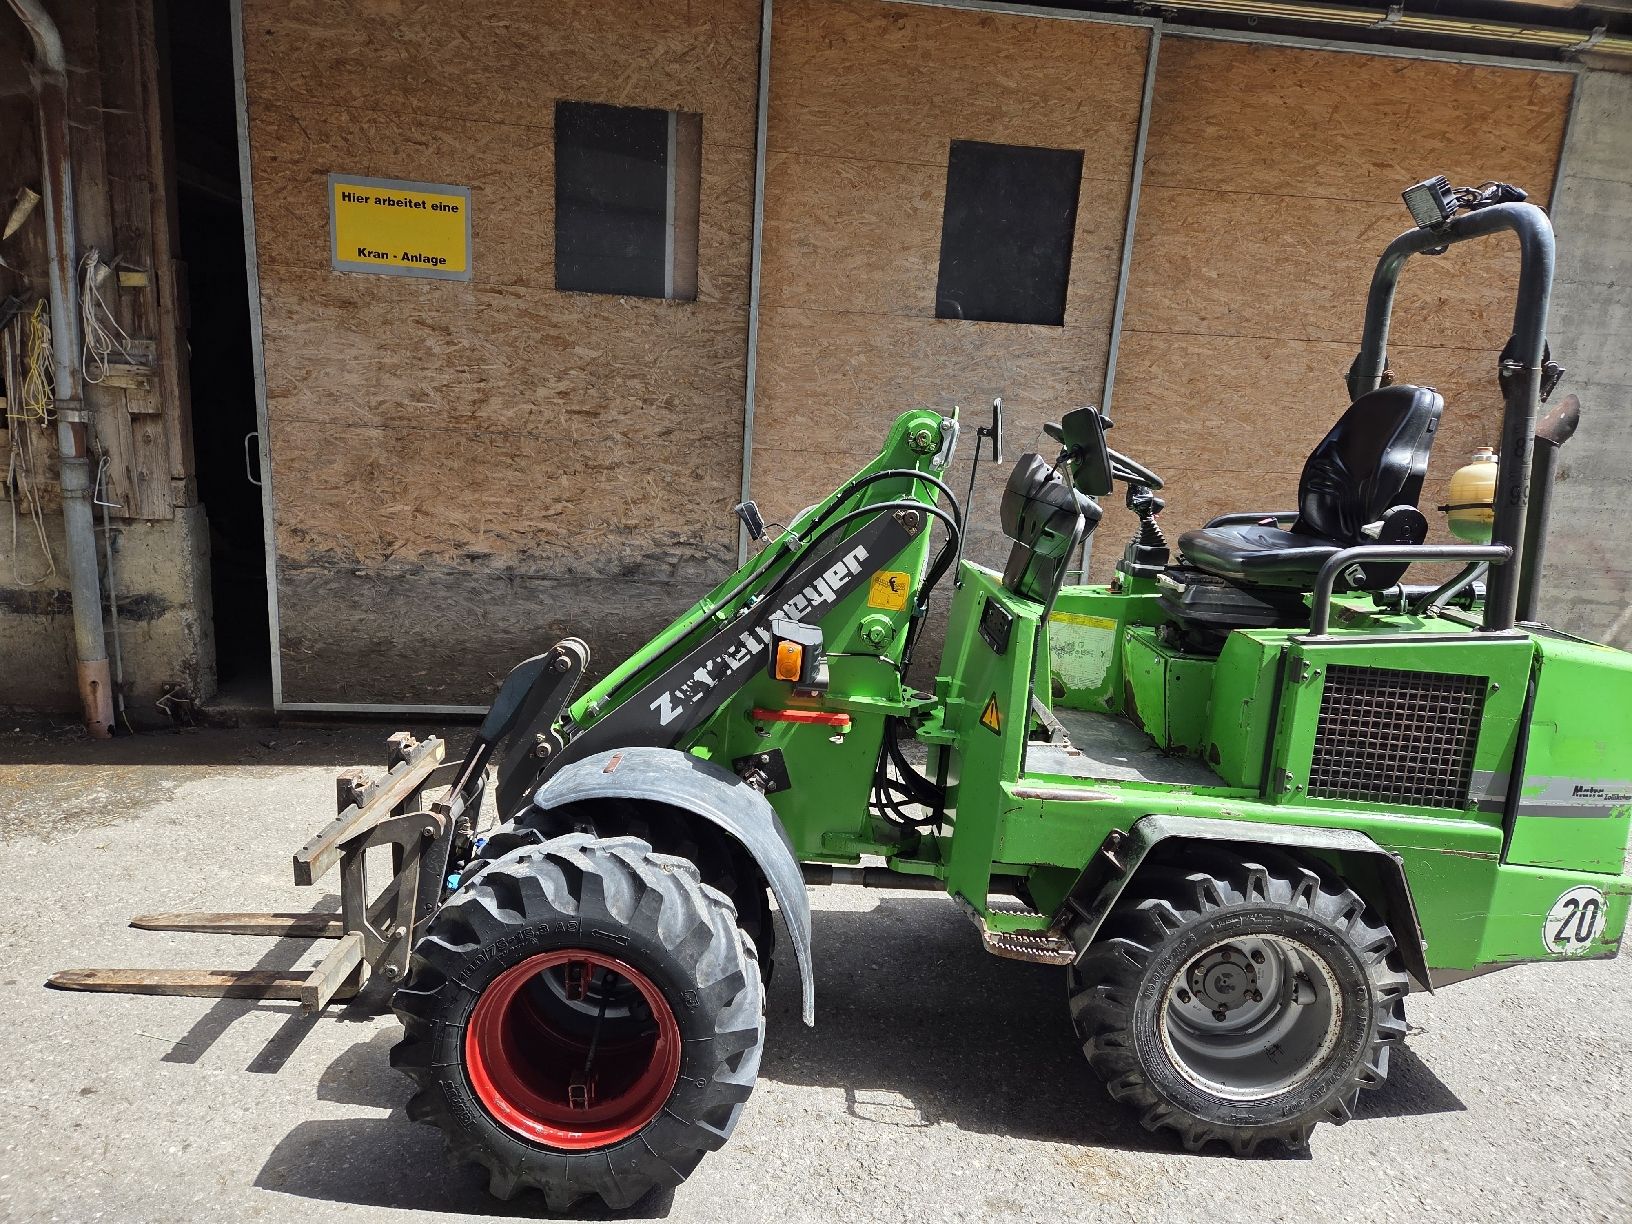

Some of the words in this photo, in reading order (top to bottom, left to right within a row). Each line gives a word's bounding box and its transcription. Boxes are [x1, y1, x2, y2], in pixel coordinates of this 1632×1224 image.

[341, 191, 370, 204] Hier
[374, 196, 427, 210] arbeitet
[431, 202, 459, 213] eine
[357, 247, 389, 260] Kran
[401, 251, 447, 267] Anlage
[1553, 897, 1600, 944] 20
